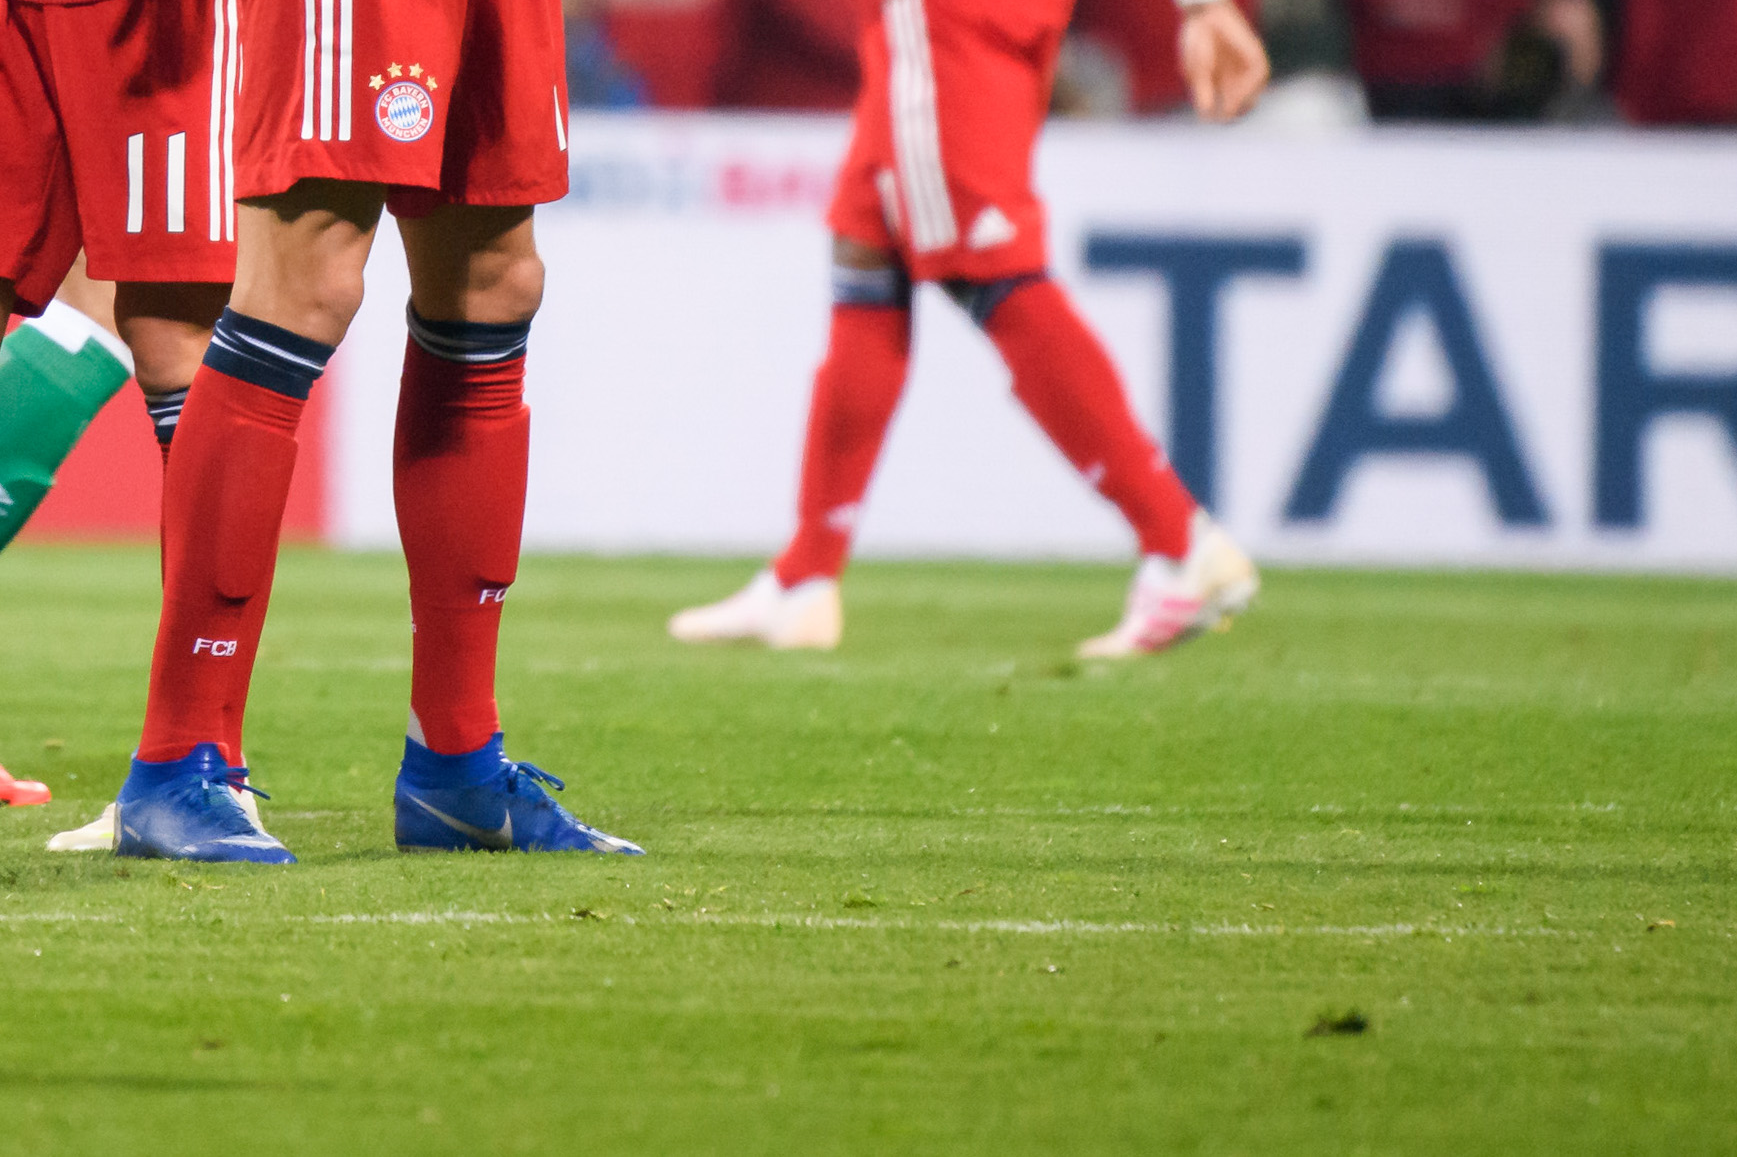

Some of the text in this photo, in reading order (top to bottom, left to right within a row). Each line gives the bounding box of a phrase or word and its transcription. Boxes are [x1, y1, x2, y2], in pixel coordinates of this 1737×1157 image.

[392, 86, 429, 109] BAYERN
[126, 131, 187, 233] 11
[192, 637, 238, 657] FCB
